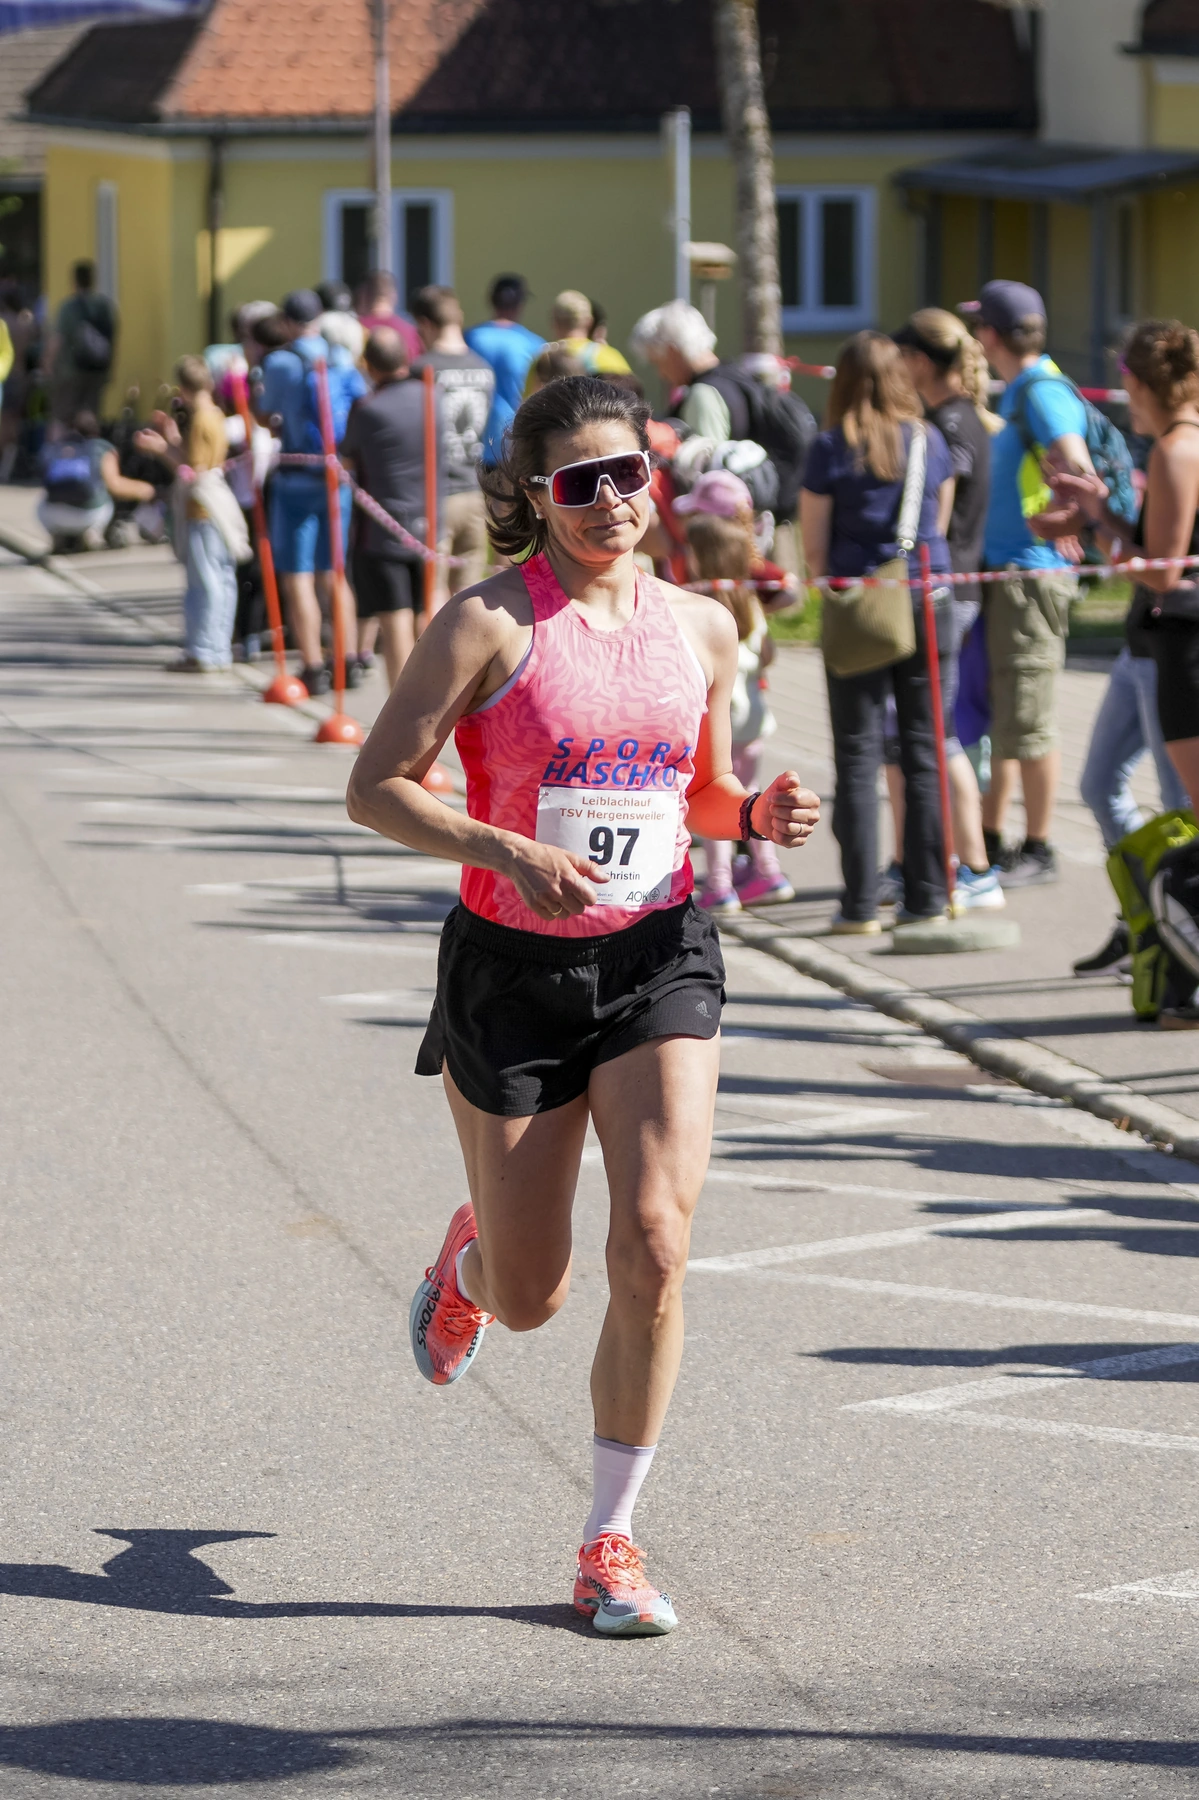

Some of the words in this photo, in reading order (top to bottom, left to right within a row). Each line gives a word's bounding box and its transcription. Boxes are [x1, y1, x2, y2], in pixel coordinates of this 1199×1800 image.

[582, 796, 651, 807] Leiblachlauf
[560, 808, 583, 818] TSV
[587, 810, 665, 821] Hergensweiler
[588, 826, 640, 866] 97
[625, 891, 649, 902] AOK
